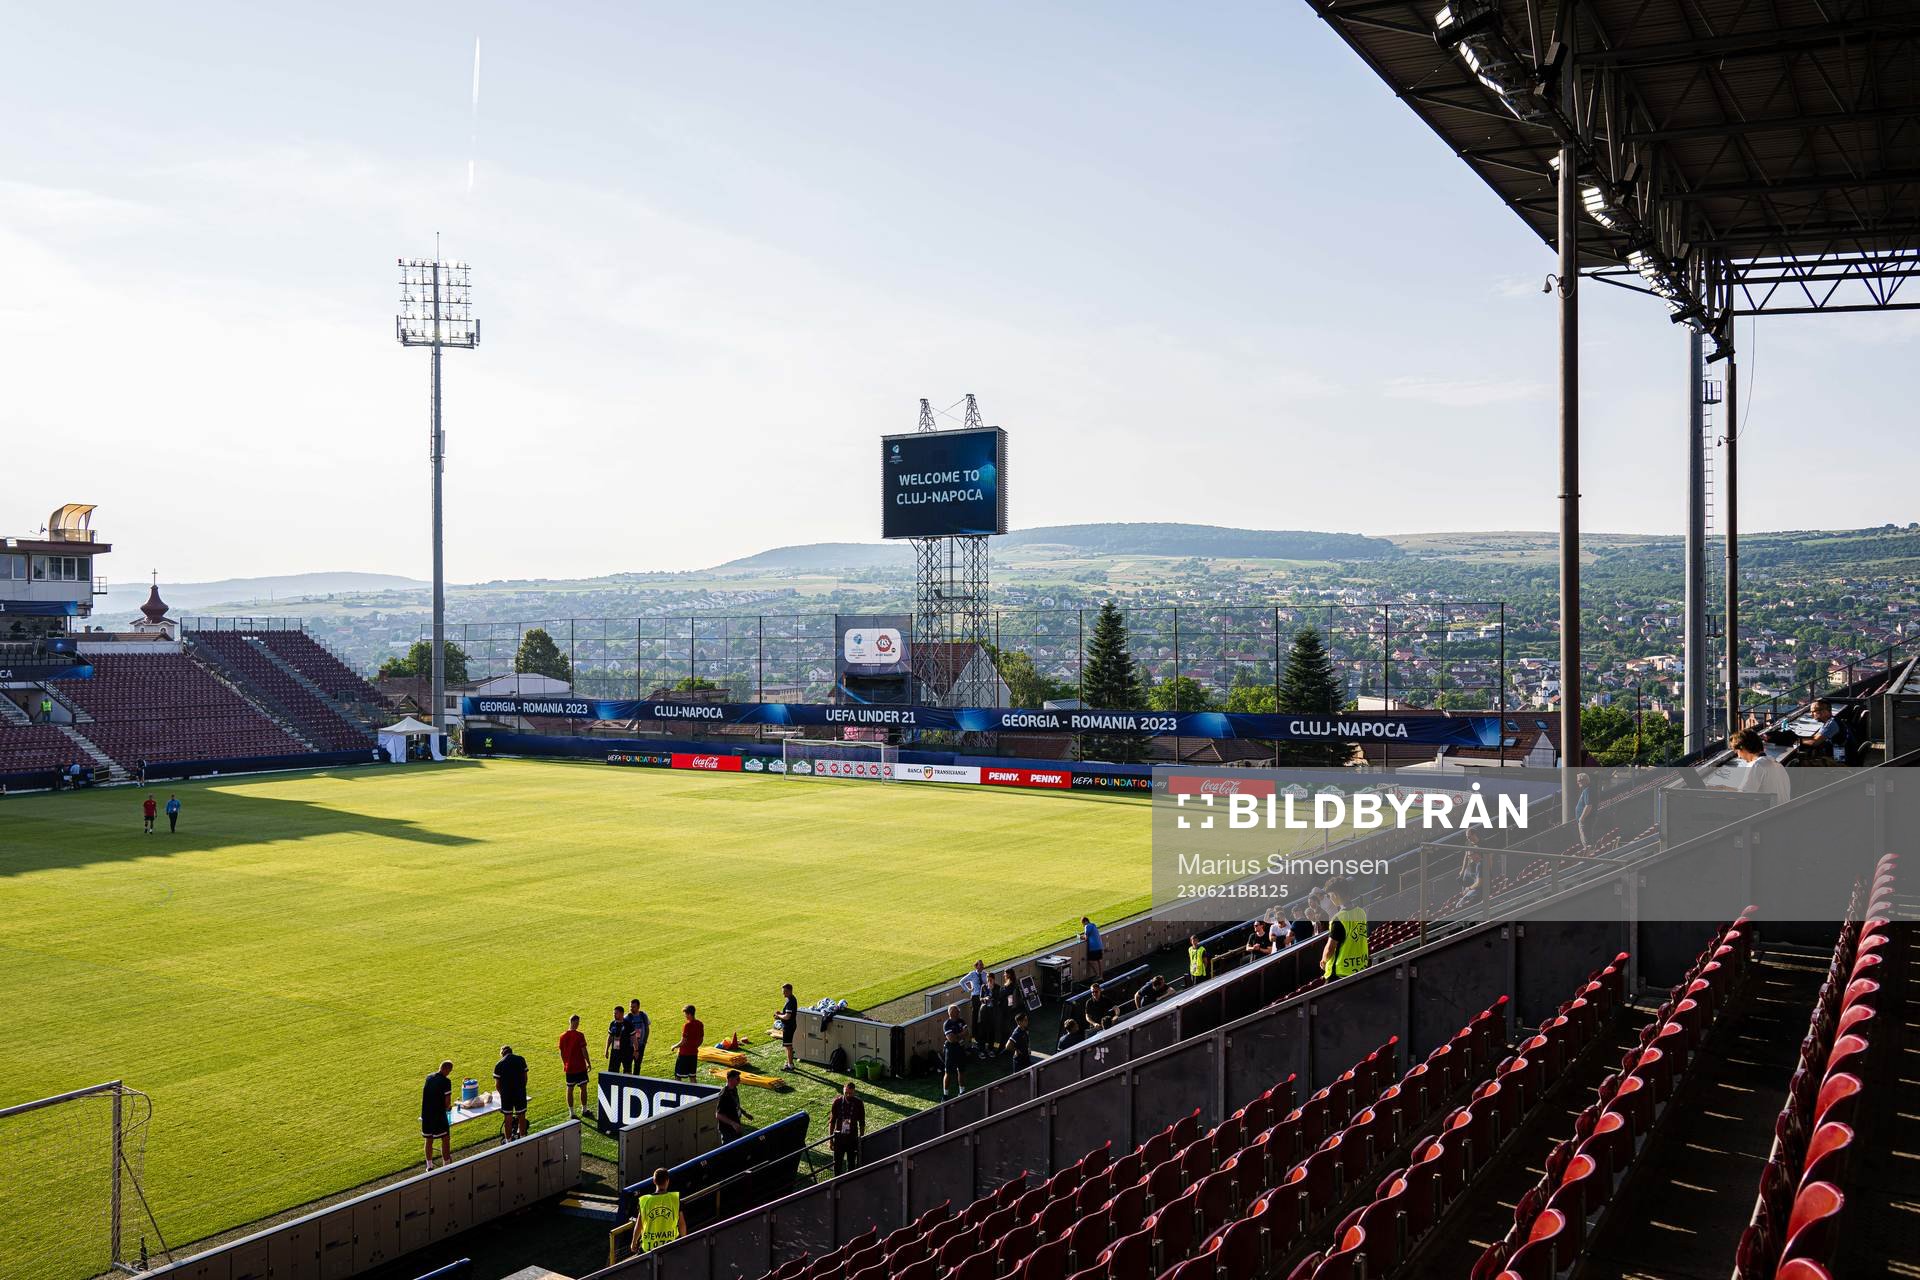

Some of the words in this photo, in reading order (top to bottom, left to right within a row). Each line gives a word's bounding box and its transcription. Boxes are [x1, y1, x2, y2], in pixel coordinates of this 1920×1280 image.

[899, 471, 960, 486] WELCOME
[963, 469, 980, 482] TO
[896, 488, 984, 505] CLUJ-NAPOCA
[480, 701, 517, 712] GEORGIA
[523, 703, 564, 714] ROMANIA
[566, 704, 588, 714] 2023
[654, 705, 723, 719] CLUJ-NAPOCA
[826, 709, 857, 722] UEFA
[858, 710, 899, 723] UNDER
[901, 711, 916, 724] 21
[1002, 713, 1060, 728] GEORGIA
[1071, 715, 1137, 730] ROMANIA
[1140, 717, 1177, 731] 2023
[1289, 720, 1409, 738] CLUJ-NAPOCA
[1072, 776, 1093, 785] UEFA
[648, 1208, 671, 1220] UEFA
